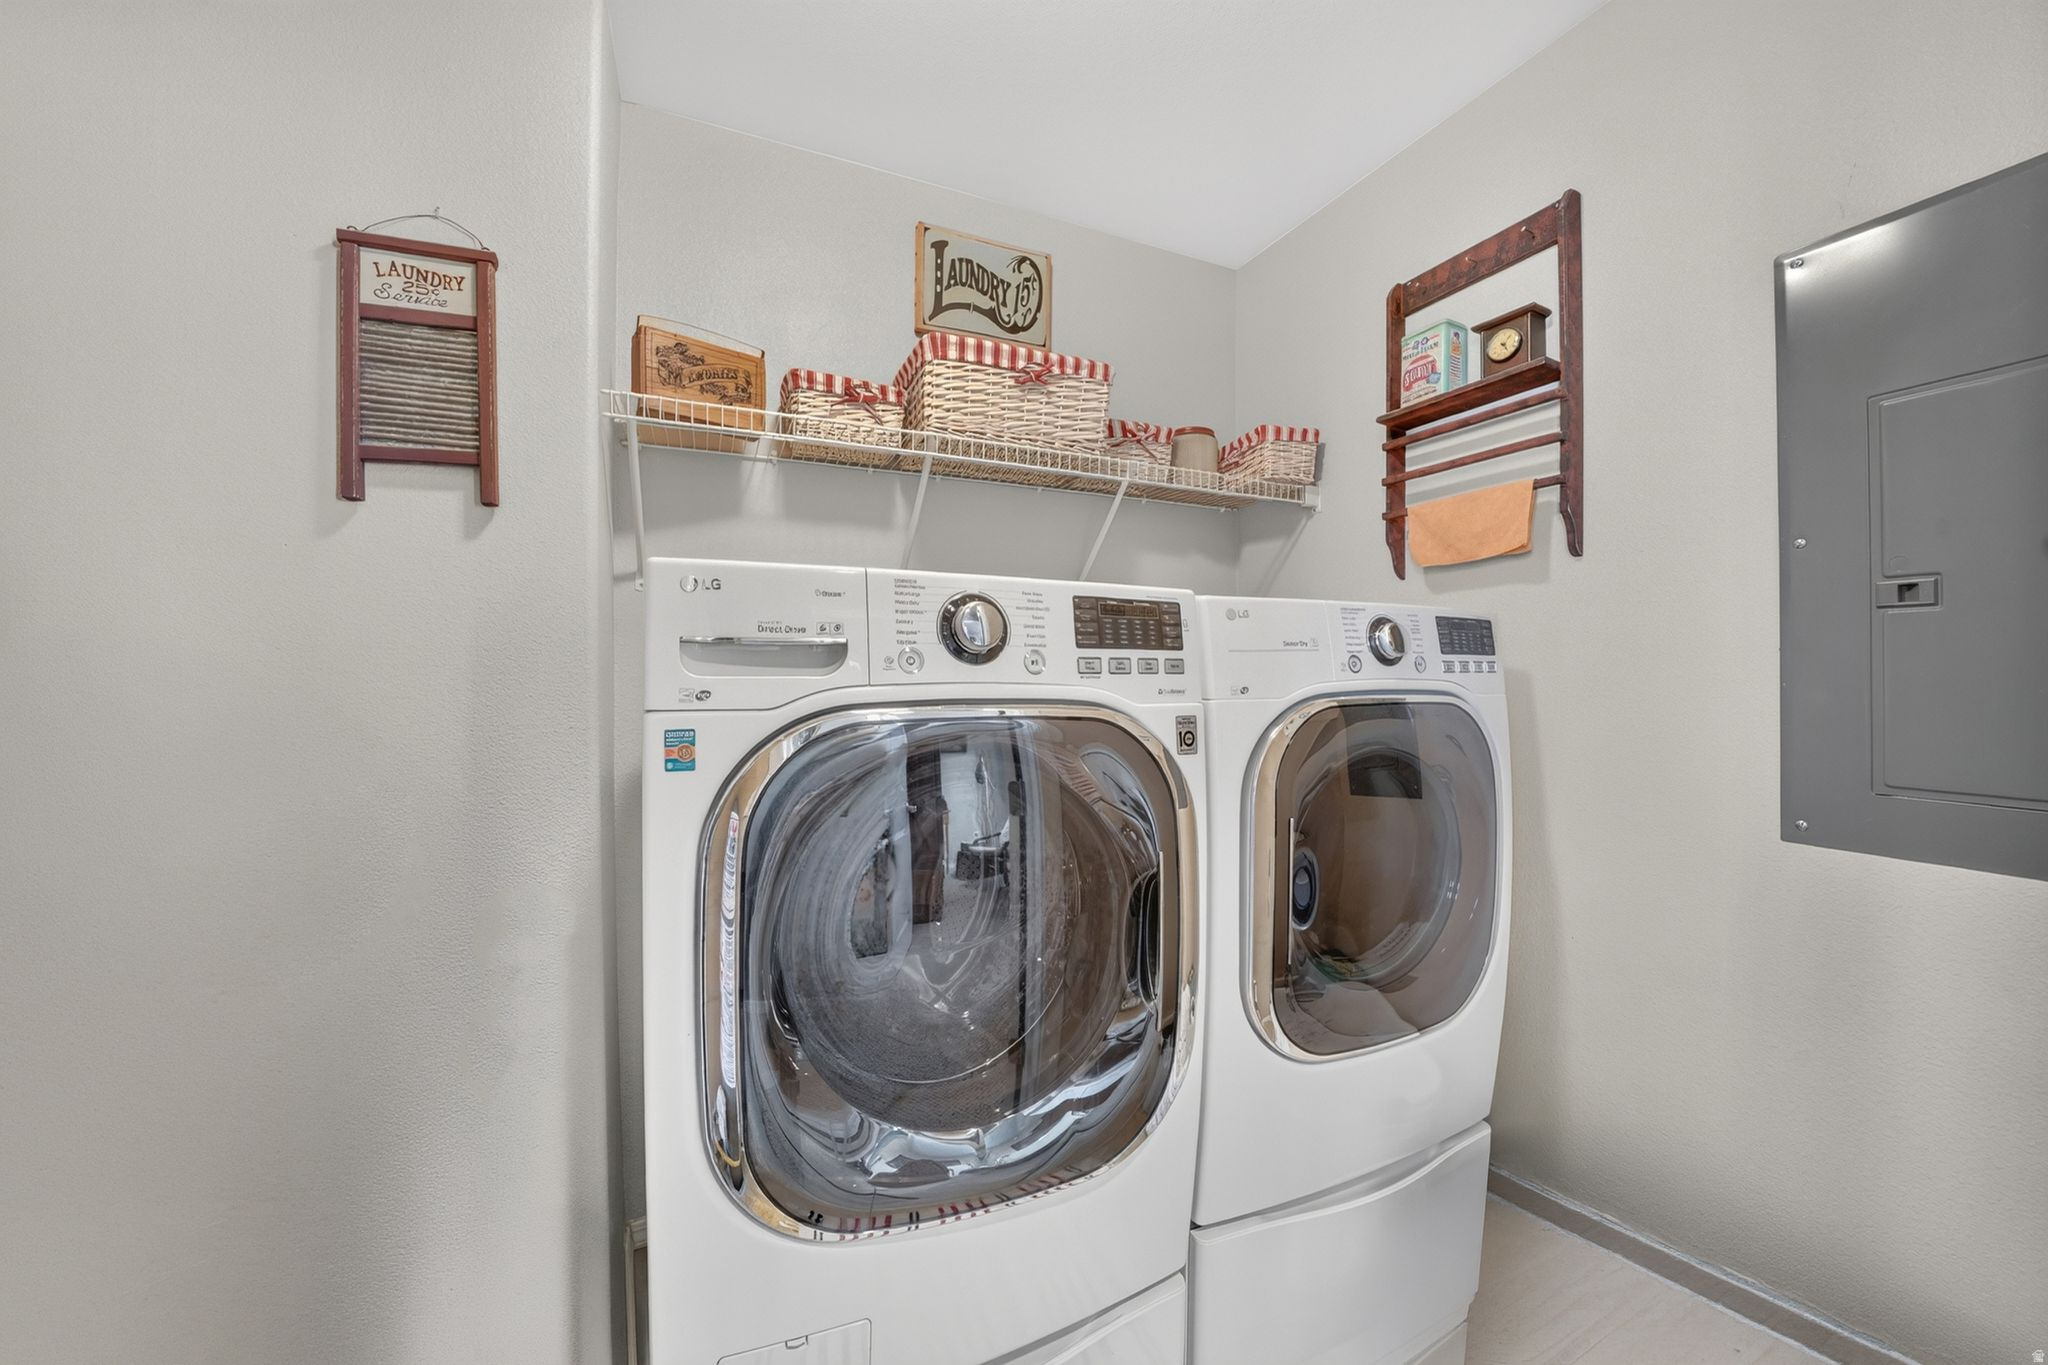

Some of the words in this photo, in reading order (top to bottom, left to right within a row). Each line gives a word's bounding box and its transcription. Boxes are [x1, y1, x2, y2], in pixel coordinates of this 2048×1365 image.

[373, 260, 466, 291] LAUNDRY
[928, 239, 1011, 322] LAUNDRY
[373, 282, 449, 308] Service
[702, 578, 722, 591] LG
[1237, 609, 1250, 619] LG
[1178, 730, 1196, 748] 10
